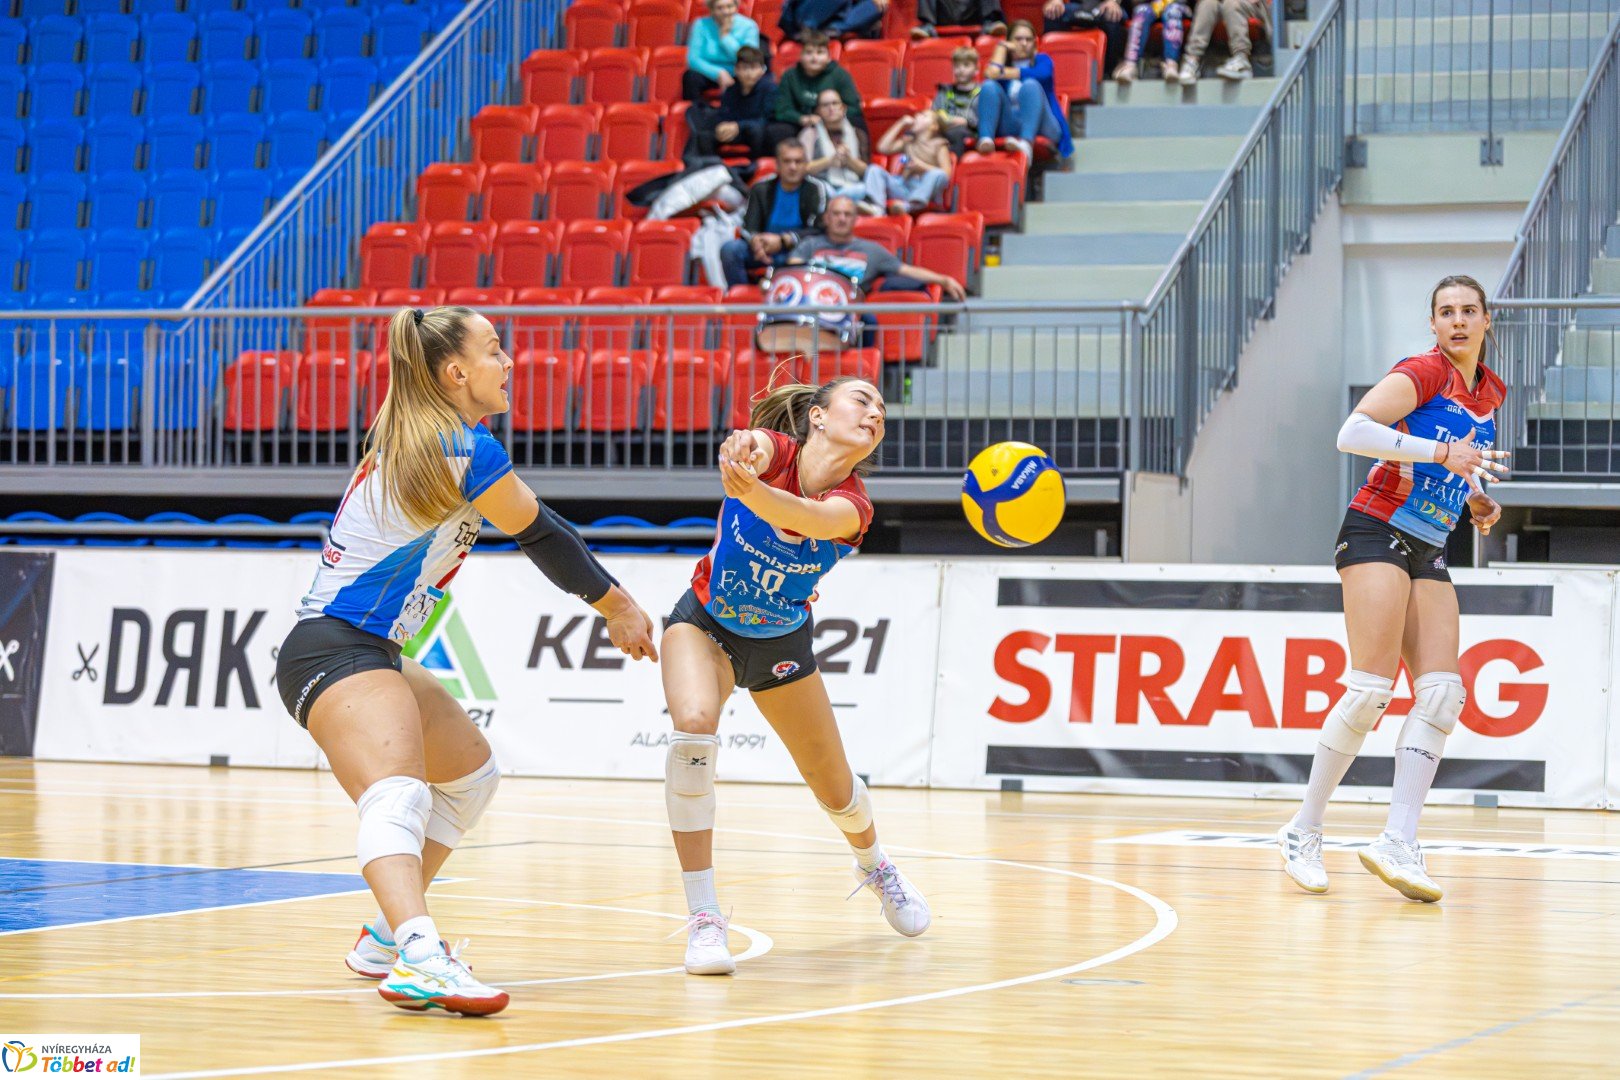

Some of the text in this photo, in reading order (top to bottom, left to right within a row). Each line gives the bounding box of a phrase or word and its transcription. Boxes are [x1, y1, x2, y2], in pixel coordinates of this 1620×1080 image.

[749, 560, 786, 596] 10
[812, 617, 891, 675] 21
[728, 733, 767, 750] 1991
